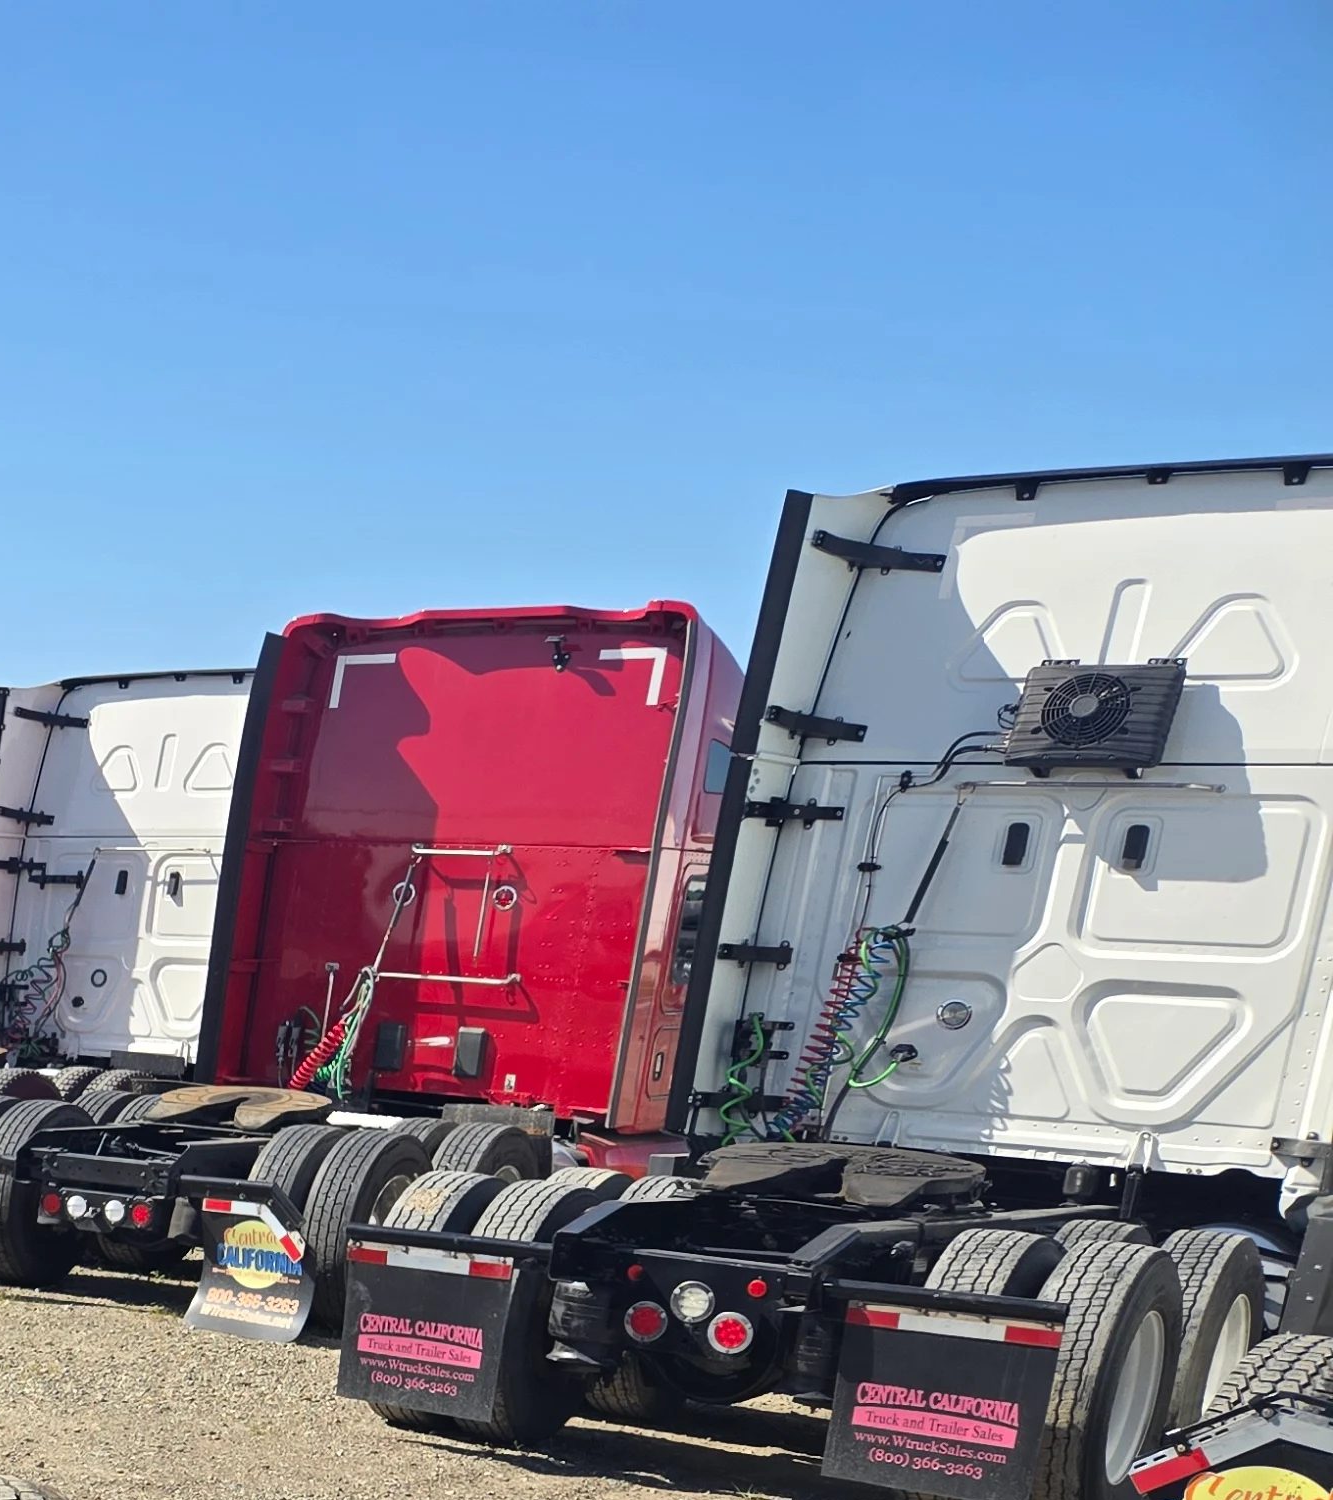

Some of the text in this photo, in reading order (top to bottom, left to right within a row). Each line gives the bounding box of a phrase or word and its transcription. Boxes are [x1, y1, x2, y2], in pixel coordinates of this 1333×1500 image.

[216, 1242, 303, 1276] CALIFORNIA
[205, 1287, 300, 1315] 800-366-3263
[360, 1312, 483, 1350] CENTRAL CALIFORNIA
[367, 1337, 472, 1363] Truck and Trailer Sales
[359, 1356, 475, 1383] www.WtruckSales.com
[370, 1370, 458, 1397] (800) 366-3263
[856, 1382, 1020, 1427] CENTRAL CALIFORNIA
[865, 1410, 1004, 1443] Truck and Trailer Sales
[853, 1431, 1008, 1465] www.WtruckSales.com
[868, 1446, 983, 1480] (800) 366-3263
